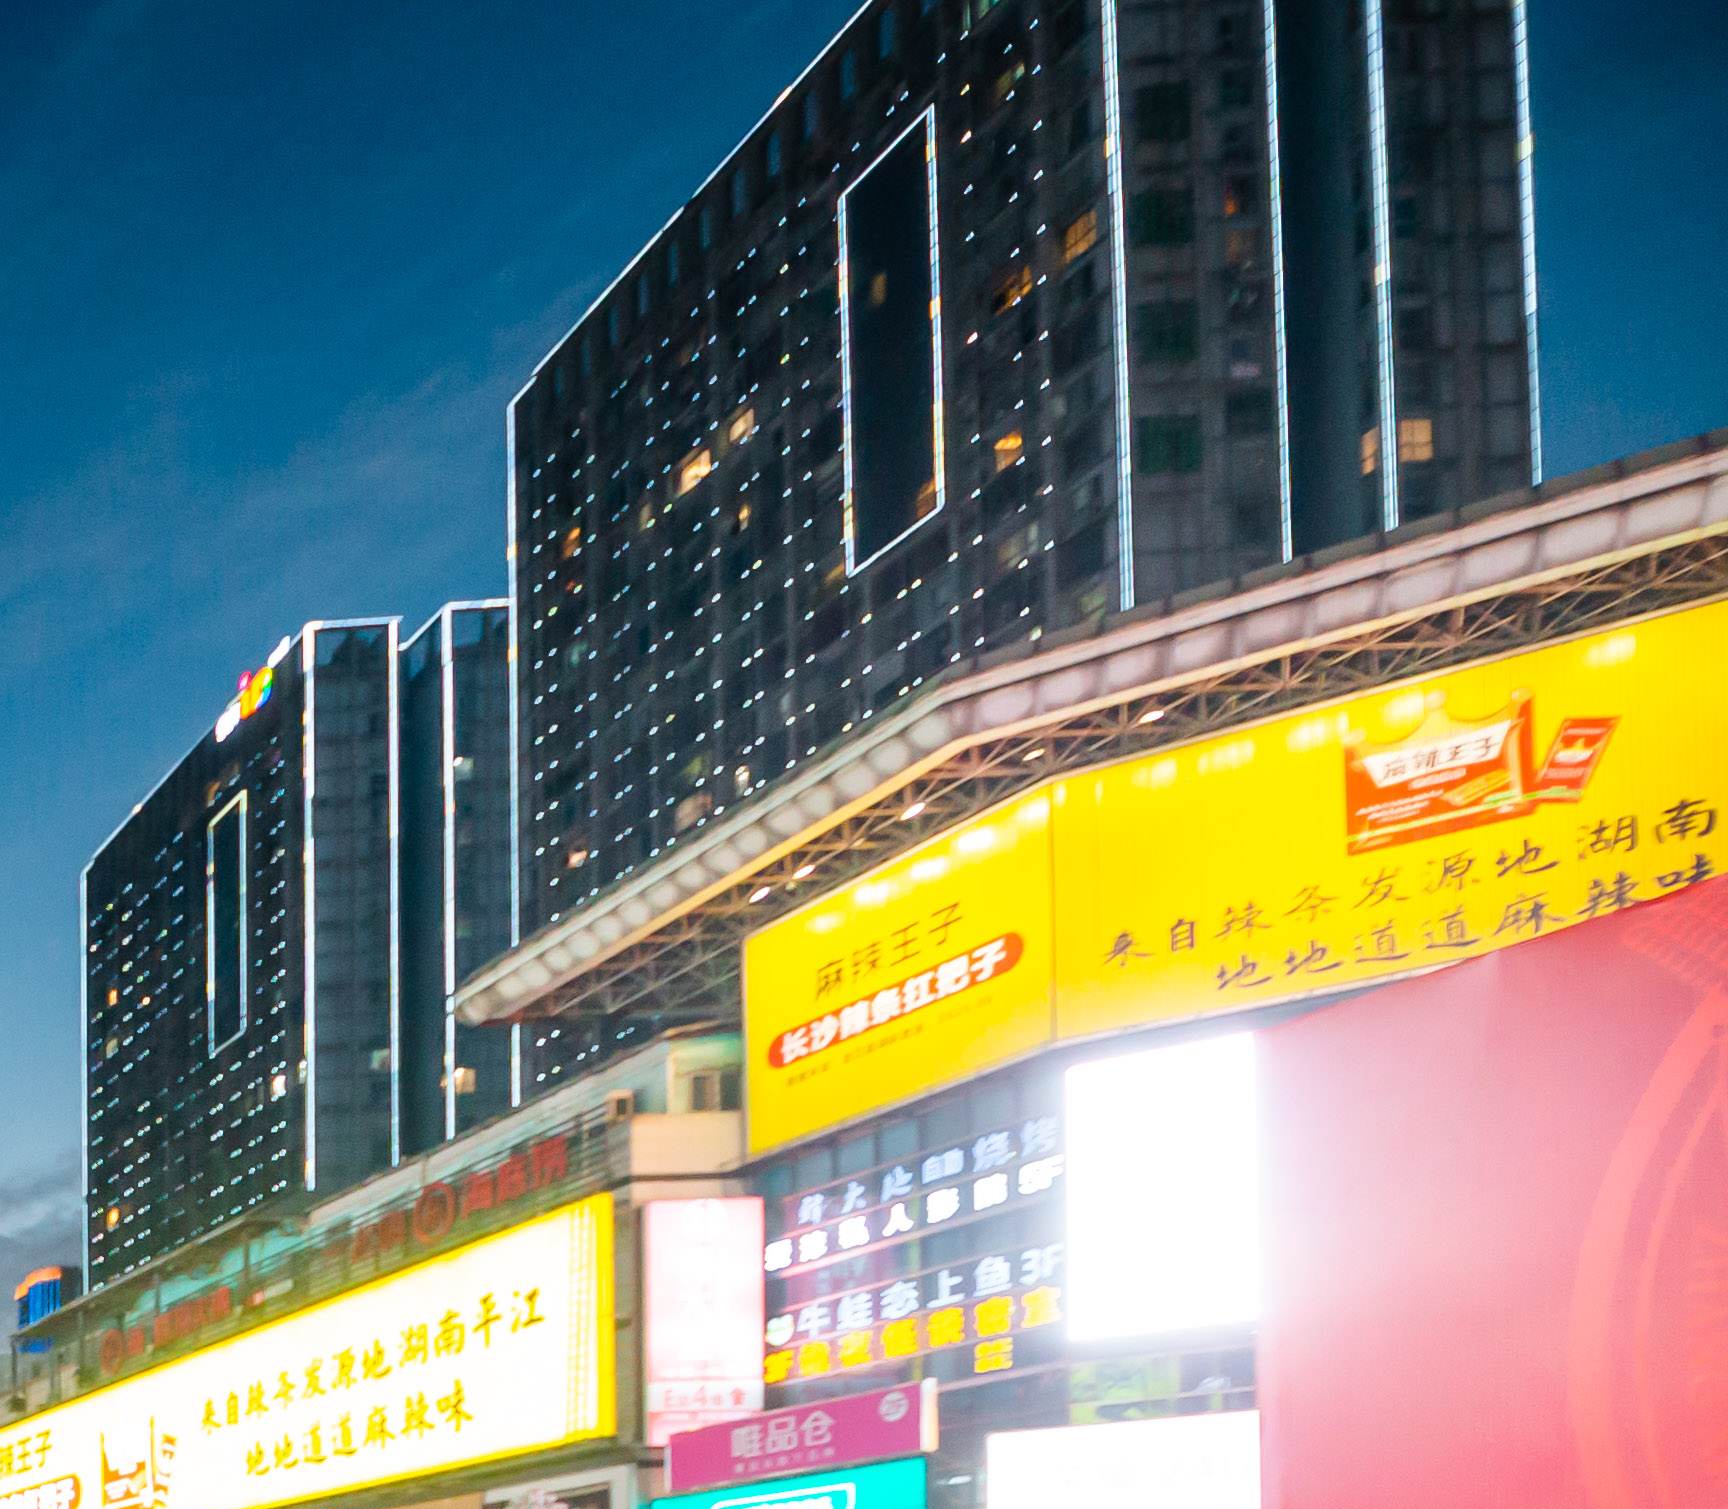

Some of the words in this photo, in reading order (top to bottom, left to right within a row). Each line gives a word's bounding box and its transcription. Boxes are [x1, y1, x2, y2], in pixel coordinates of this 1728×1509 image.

[201, 1287, 546, 1435] 来自辣条发源地湖南平江
[246, 1379, 473, 1476] 地地道道麻辣味
